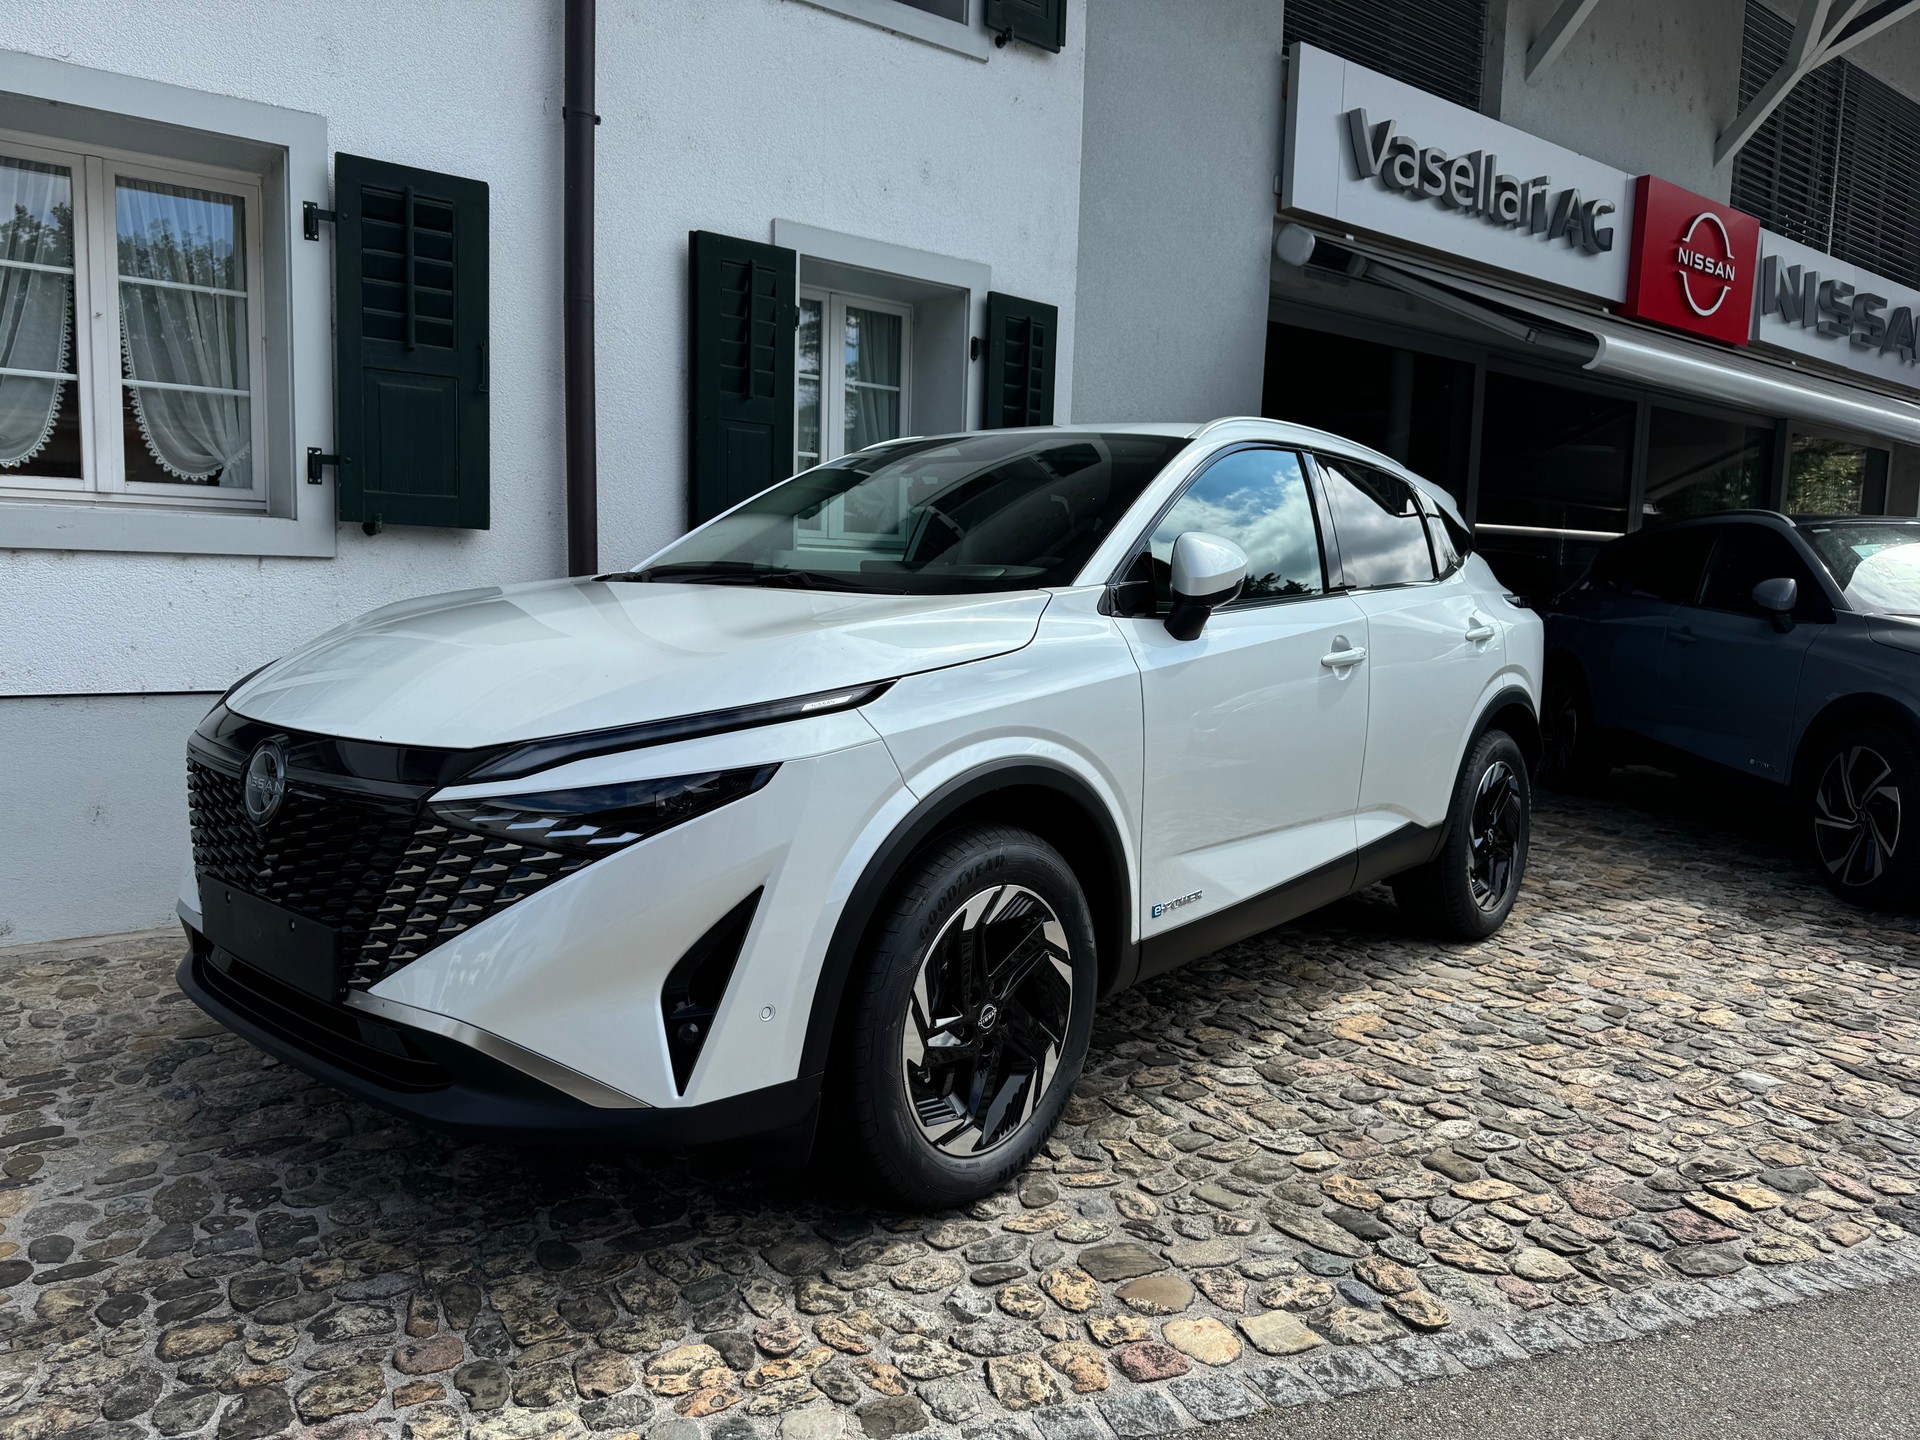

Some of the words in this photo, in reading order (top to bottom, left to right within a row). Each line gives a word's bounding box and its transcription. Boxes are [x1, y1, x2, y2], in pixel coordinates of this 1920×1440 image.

[1348, 107, 1551, 235] Vasellari
[1549, 188, 1615, 253] AG
[1678, 246, 1735, 281] NISSAN
[1762, 255, 1920, 363] NISSA
[919, 855, 1005, 940] GOODYEAR
